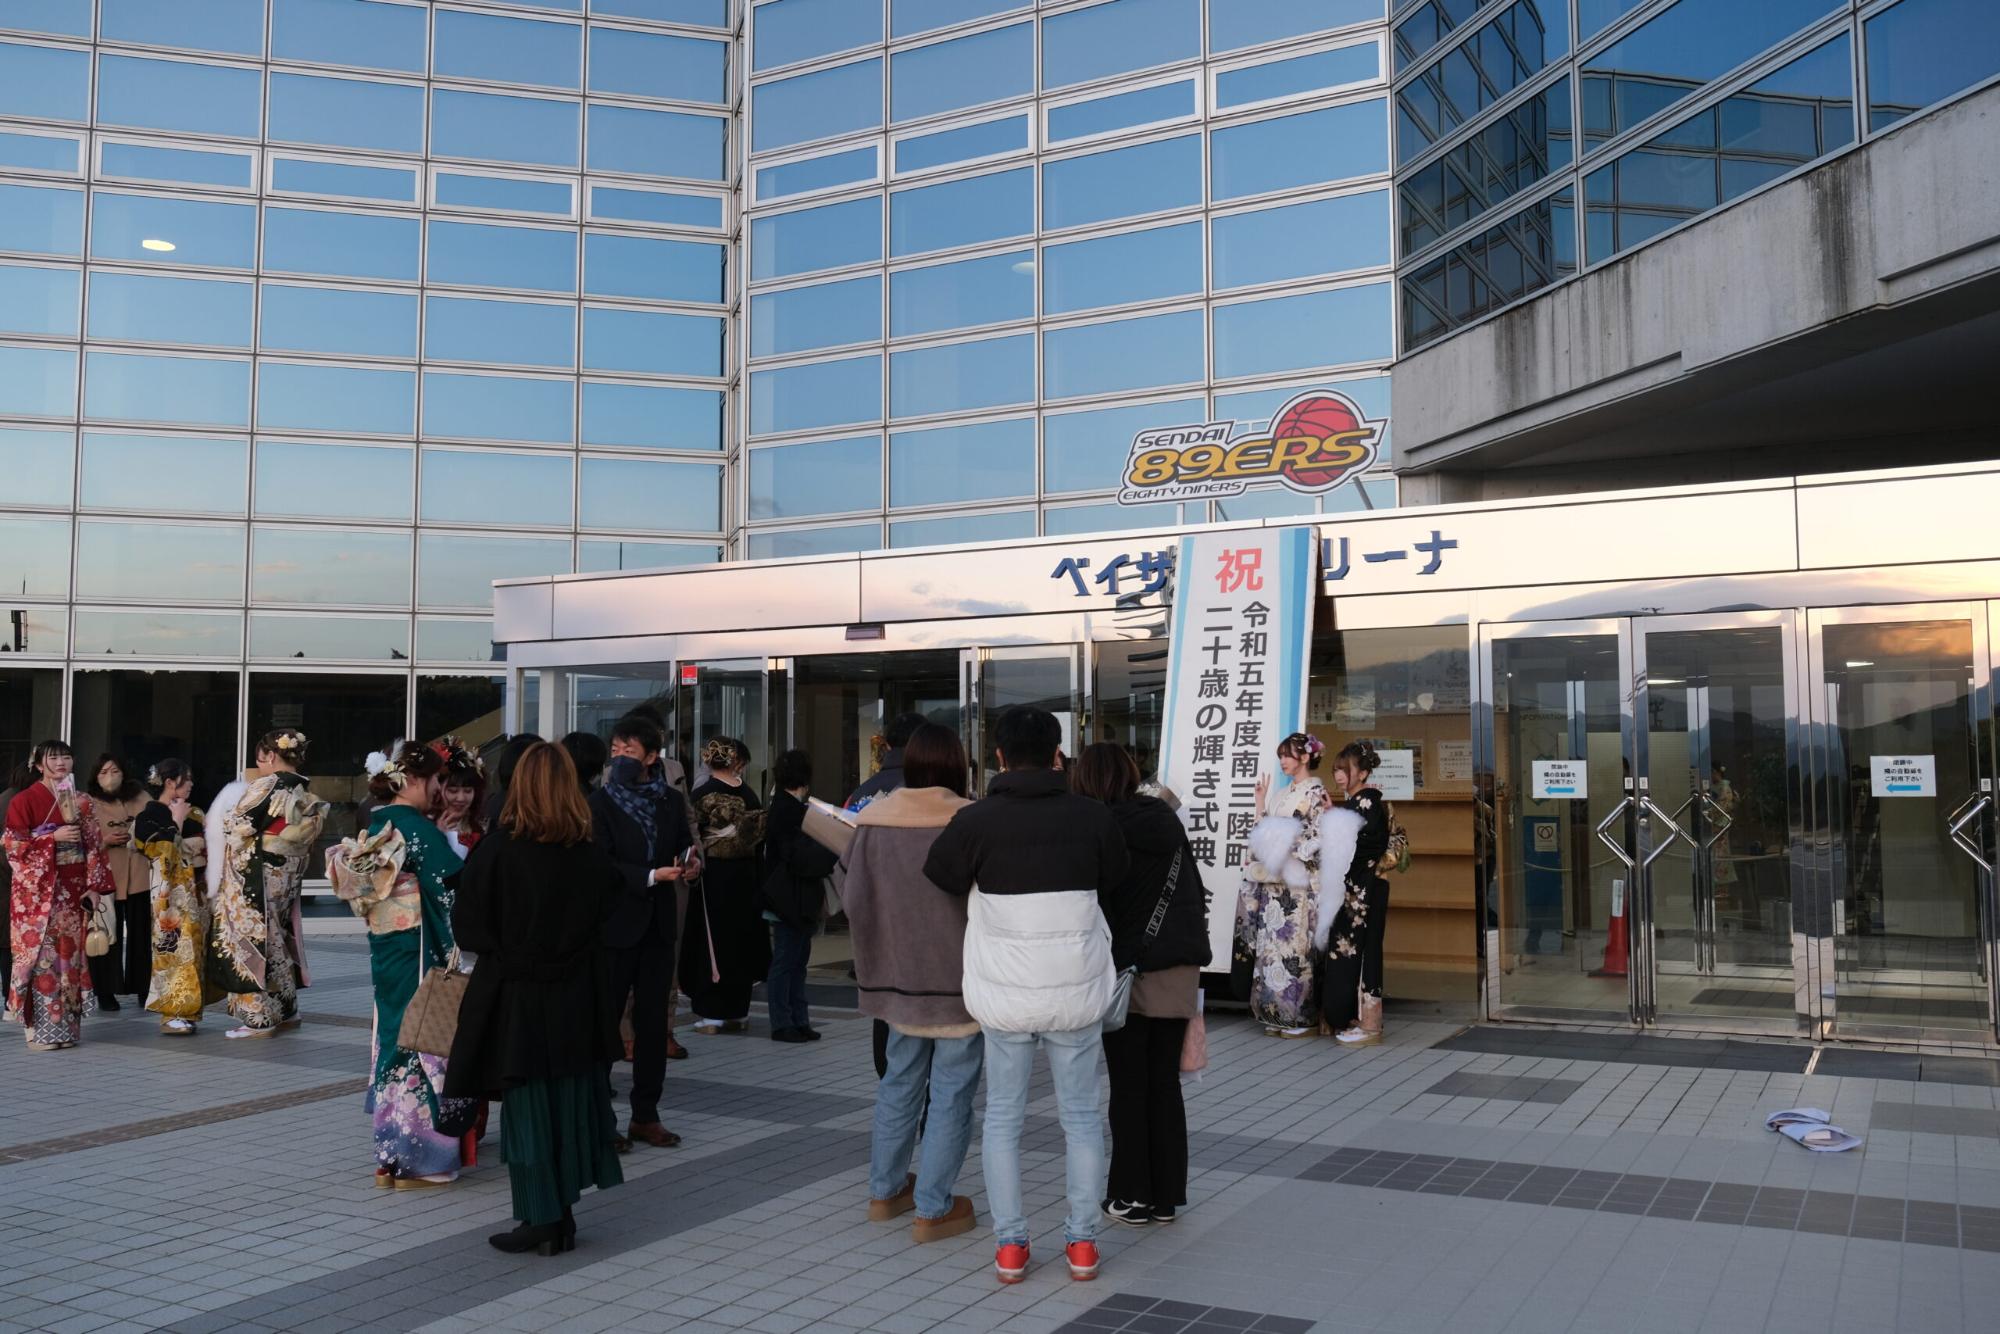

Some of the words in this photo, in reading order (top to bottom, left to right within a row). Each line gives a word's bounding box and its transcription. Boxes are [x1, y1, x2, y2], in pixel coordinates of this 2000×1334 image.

[1138, 428, 1225, 449] SENDAI
[1129, 428, 1374, 485] 89ERS
[1123, 486, 1181, 500] EIGHTY
[1182, 481, 1242, 494] NINERS
[1215, 548, 1264, 594] 祝
